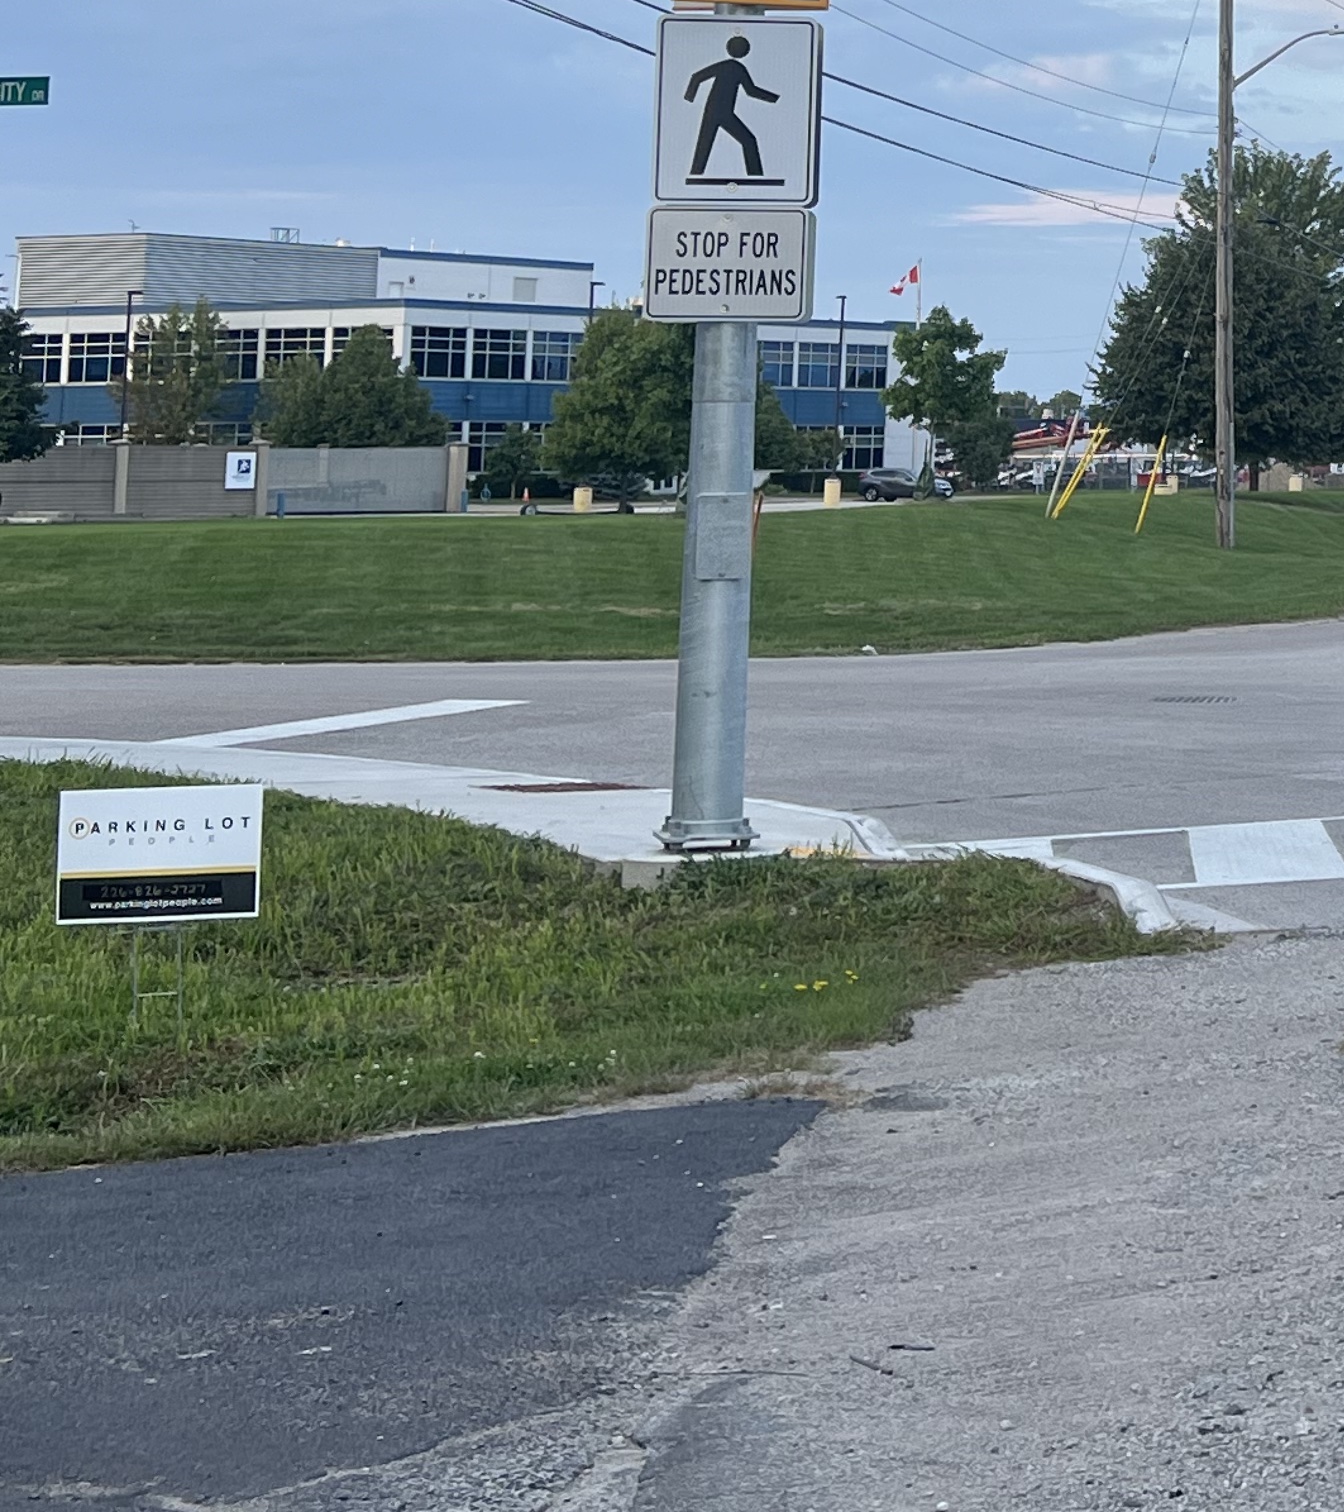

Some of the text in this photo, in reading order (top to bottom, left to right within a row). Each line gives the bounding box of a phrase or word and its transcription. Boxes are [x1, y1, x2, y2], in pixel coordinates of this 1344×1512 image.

[0, 81, 27, 102] ITY
[675, 231, 779, 258] STOP FOR
[654, 268, 797, 296] PEDESTRIANS
[75, 816, 251, 834] PARKING LOT
[108, 835, 215, 846] PEOPLE
[89, 897, 223, 909] www.parkinglotpeople.com
